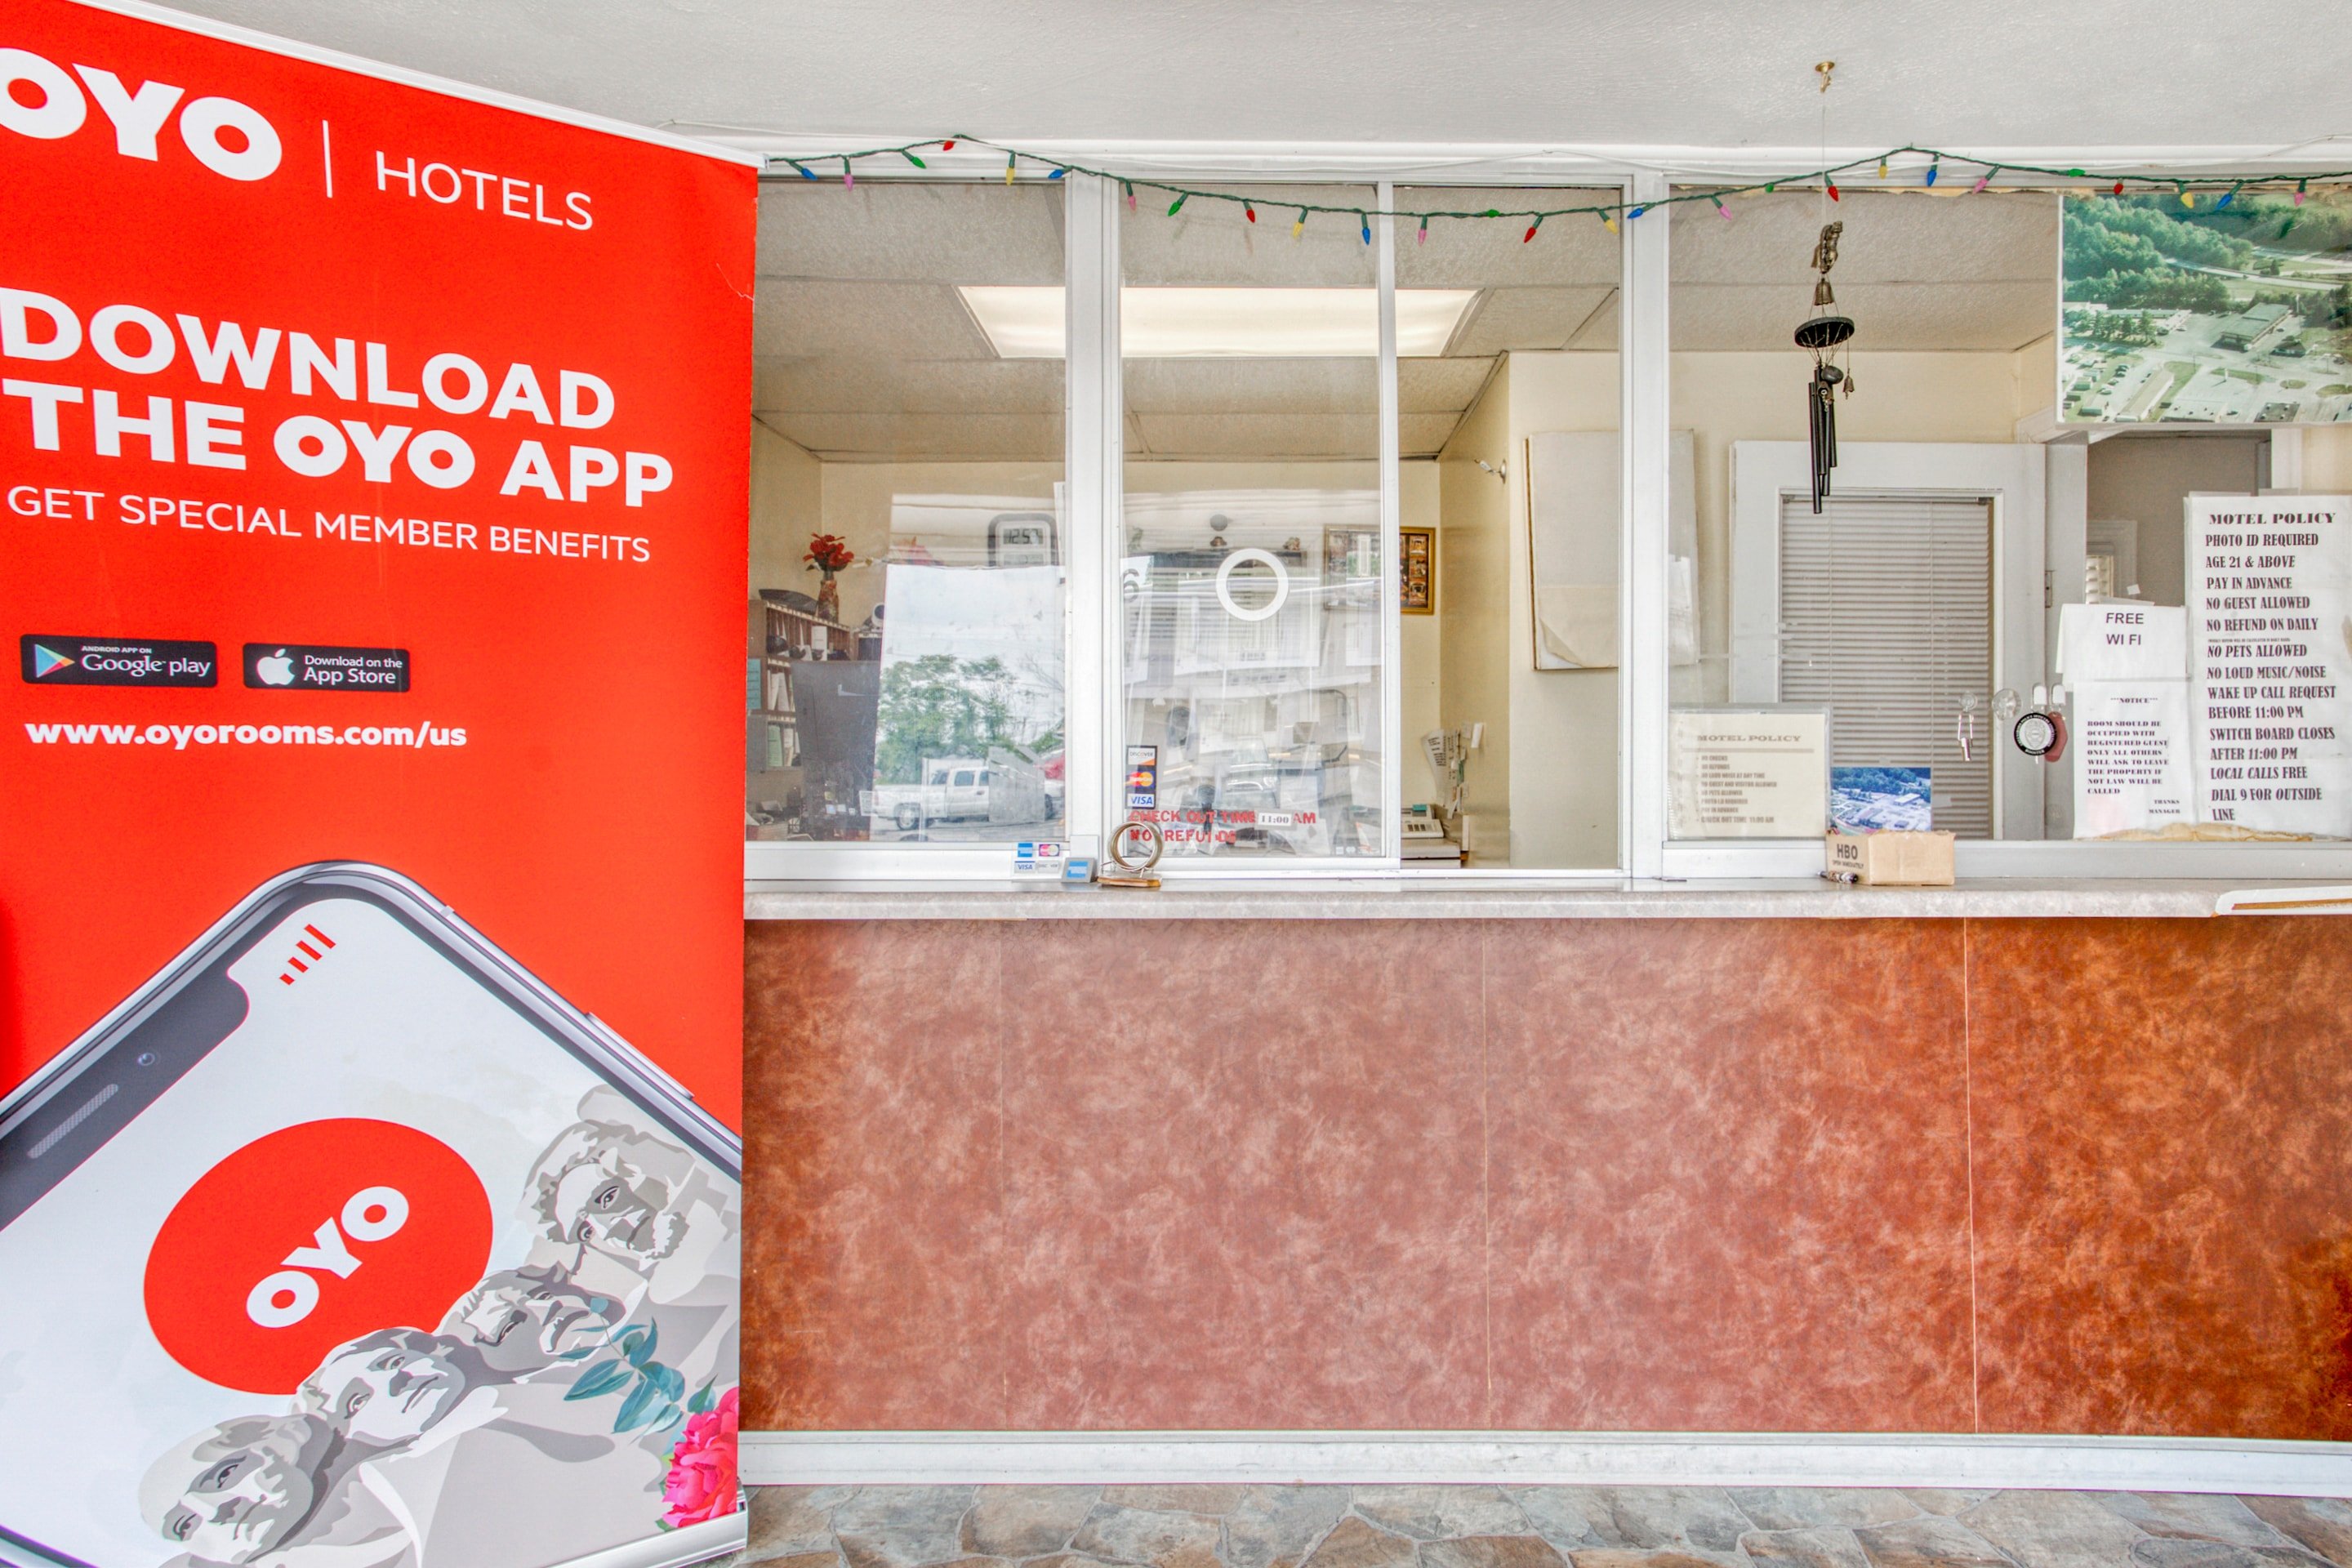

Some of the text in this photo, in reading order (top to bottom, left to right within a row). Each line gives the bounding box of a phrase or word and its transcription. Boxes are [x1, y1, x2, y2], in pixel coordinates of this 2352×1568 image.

[0, 47, 283, 181] OYO
[375, 150, 595, 231] HOTELS
[0, 287, 616, 430] DOWNLOAD
[2, 377, 674, 508] THE OYO APP
[7, 486, 652, 563] GET SPECIAL MEMBER BENEFITS
[2209, 513, 2336, 524] MOTEL POLICY
[2205, 533, 2319, 547] PHOTO ID REQUIRED
[2206, 555, 2296, 568] AGE 21 & ABOVE
[2207, 577, 2292, 589] PAY IN ADVANCE
[2206, 596, 2310, 609] NO GUEST ALLOWED
[2105, 612, 2145, 624] FREE
[2207, 617, 2319, 631] NO REFUND ON DAILY
[2105, 634, 2140, 645] WI FI
[2207, 644, 2307, 657] NO PETS ALLOWED
[82, 653, 212, 677] Google play
[304, 654, 403, 668] Download on the
[303, 666, 396, 685] App Store
[2207, 666, 2327, 679] NO LOUD MUSIC/NOISE
[2207, 685, 2336, 700] WAKE UP CALL REQUEST
[2208, 706, 2304, 719] BEFORE 11:00 PM
[24, 720, 467, 750] www.oyorooms.com/us
[2210, 727, 2336, 741] SWITCH BOARD CLOSES
[2210, 747, 2298, 760] AFTER 11:00 PM
[2210, 766, 2308, 779] LOCAL CALLS FREE
[1131, 796, 1153, 804] VISA
[2212, 787, 2323, 801] DIAL 9 FOR OUTSIDE
[1129, 810, 1316, 824] CHECK OUT TIME 11:00 AM
[2212, 808, 2235, 821] LINE
[1129, 829, 1152, 841] NO
[1837, 844, 1858, 860] HBO
[246, 1186, 409, 1328] OYO
